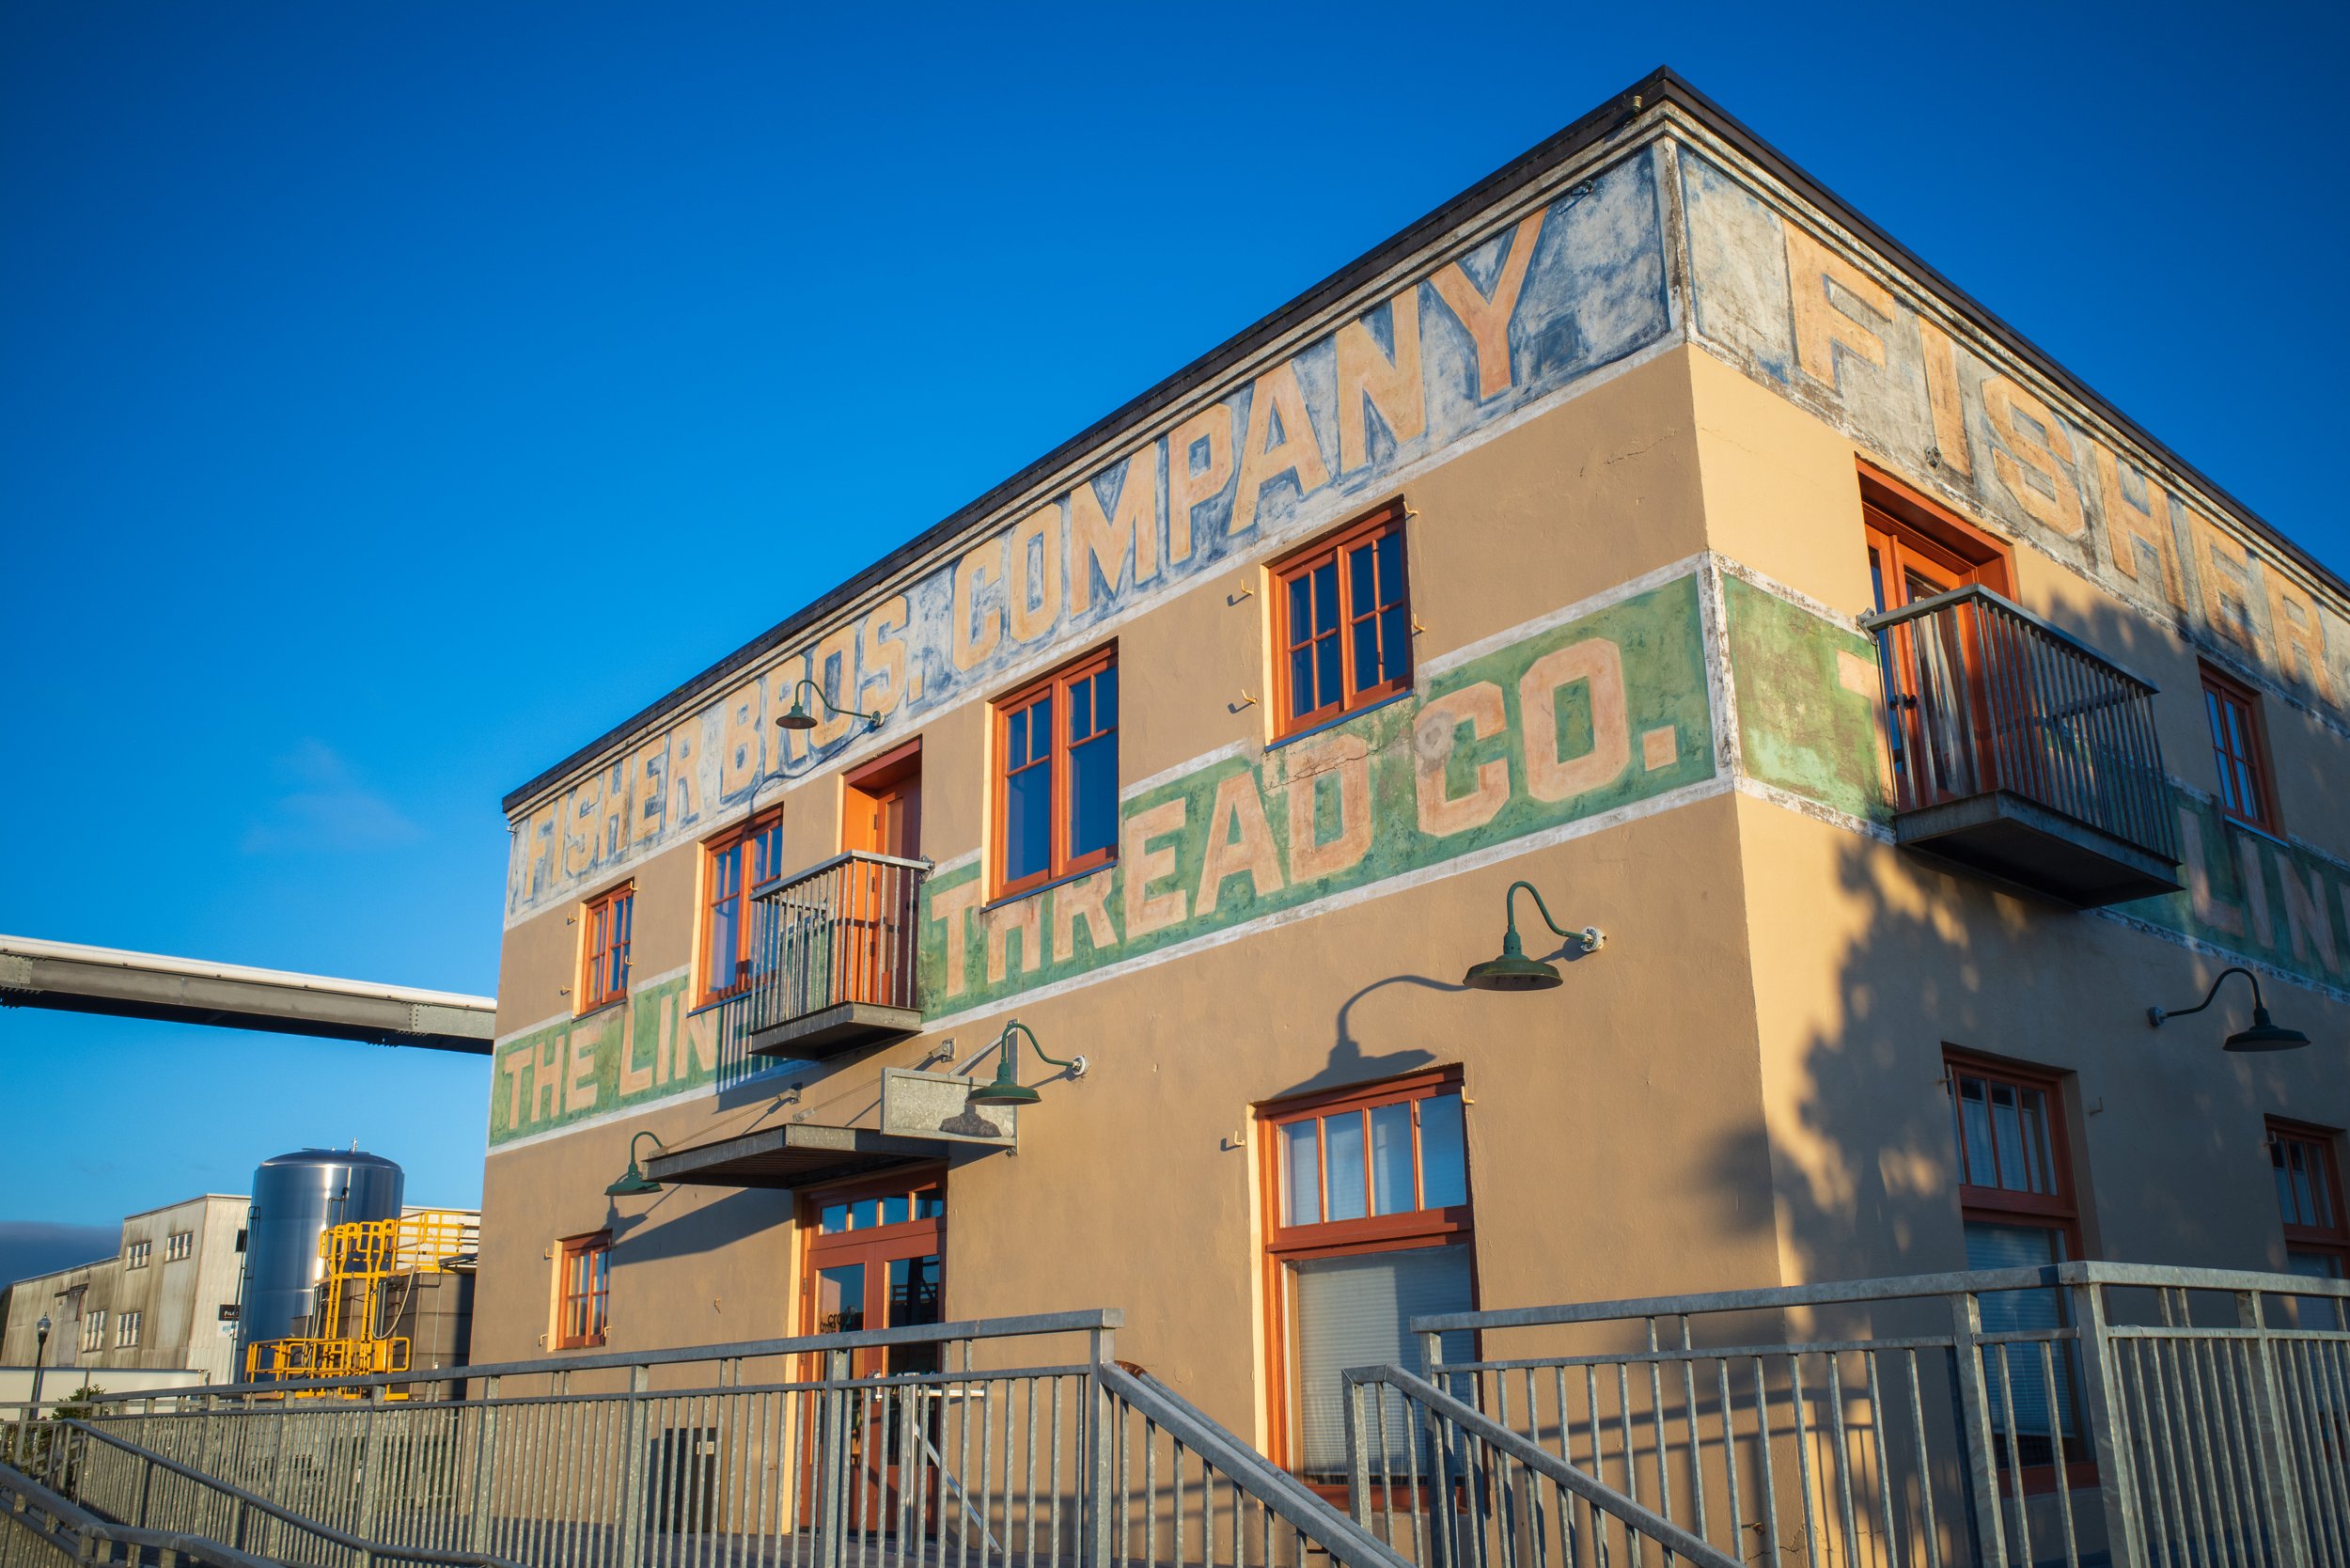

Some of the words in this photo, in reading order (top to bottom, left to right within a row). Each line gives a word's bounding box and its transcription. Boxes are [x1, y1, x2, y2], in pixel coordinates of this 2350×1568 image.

[525, 717, 702, 901] FISHER
[721, 594, 925, 797] BROS.
[952, 206, 1548, 671] COMPANY
[1783, 217, 2341, 710] FISHER
[504, 1023, 603, 1129] THE
[932, 734, 1372, 997] THREAD
[1414, 638, 1677, 837] CO.
